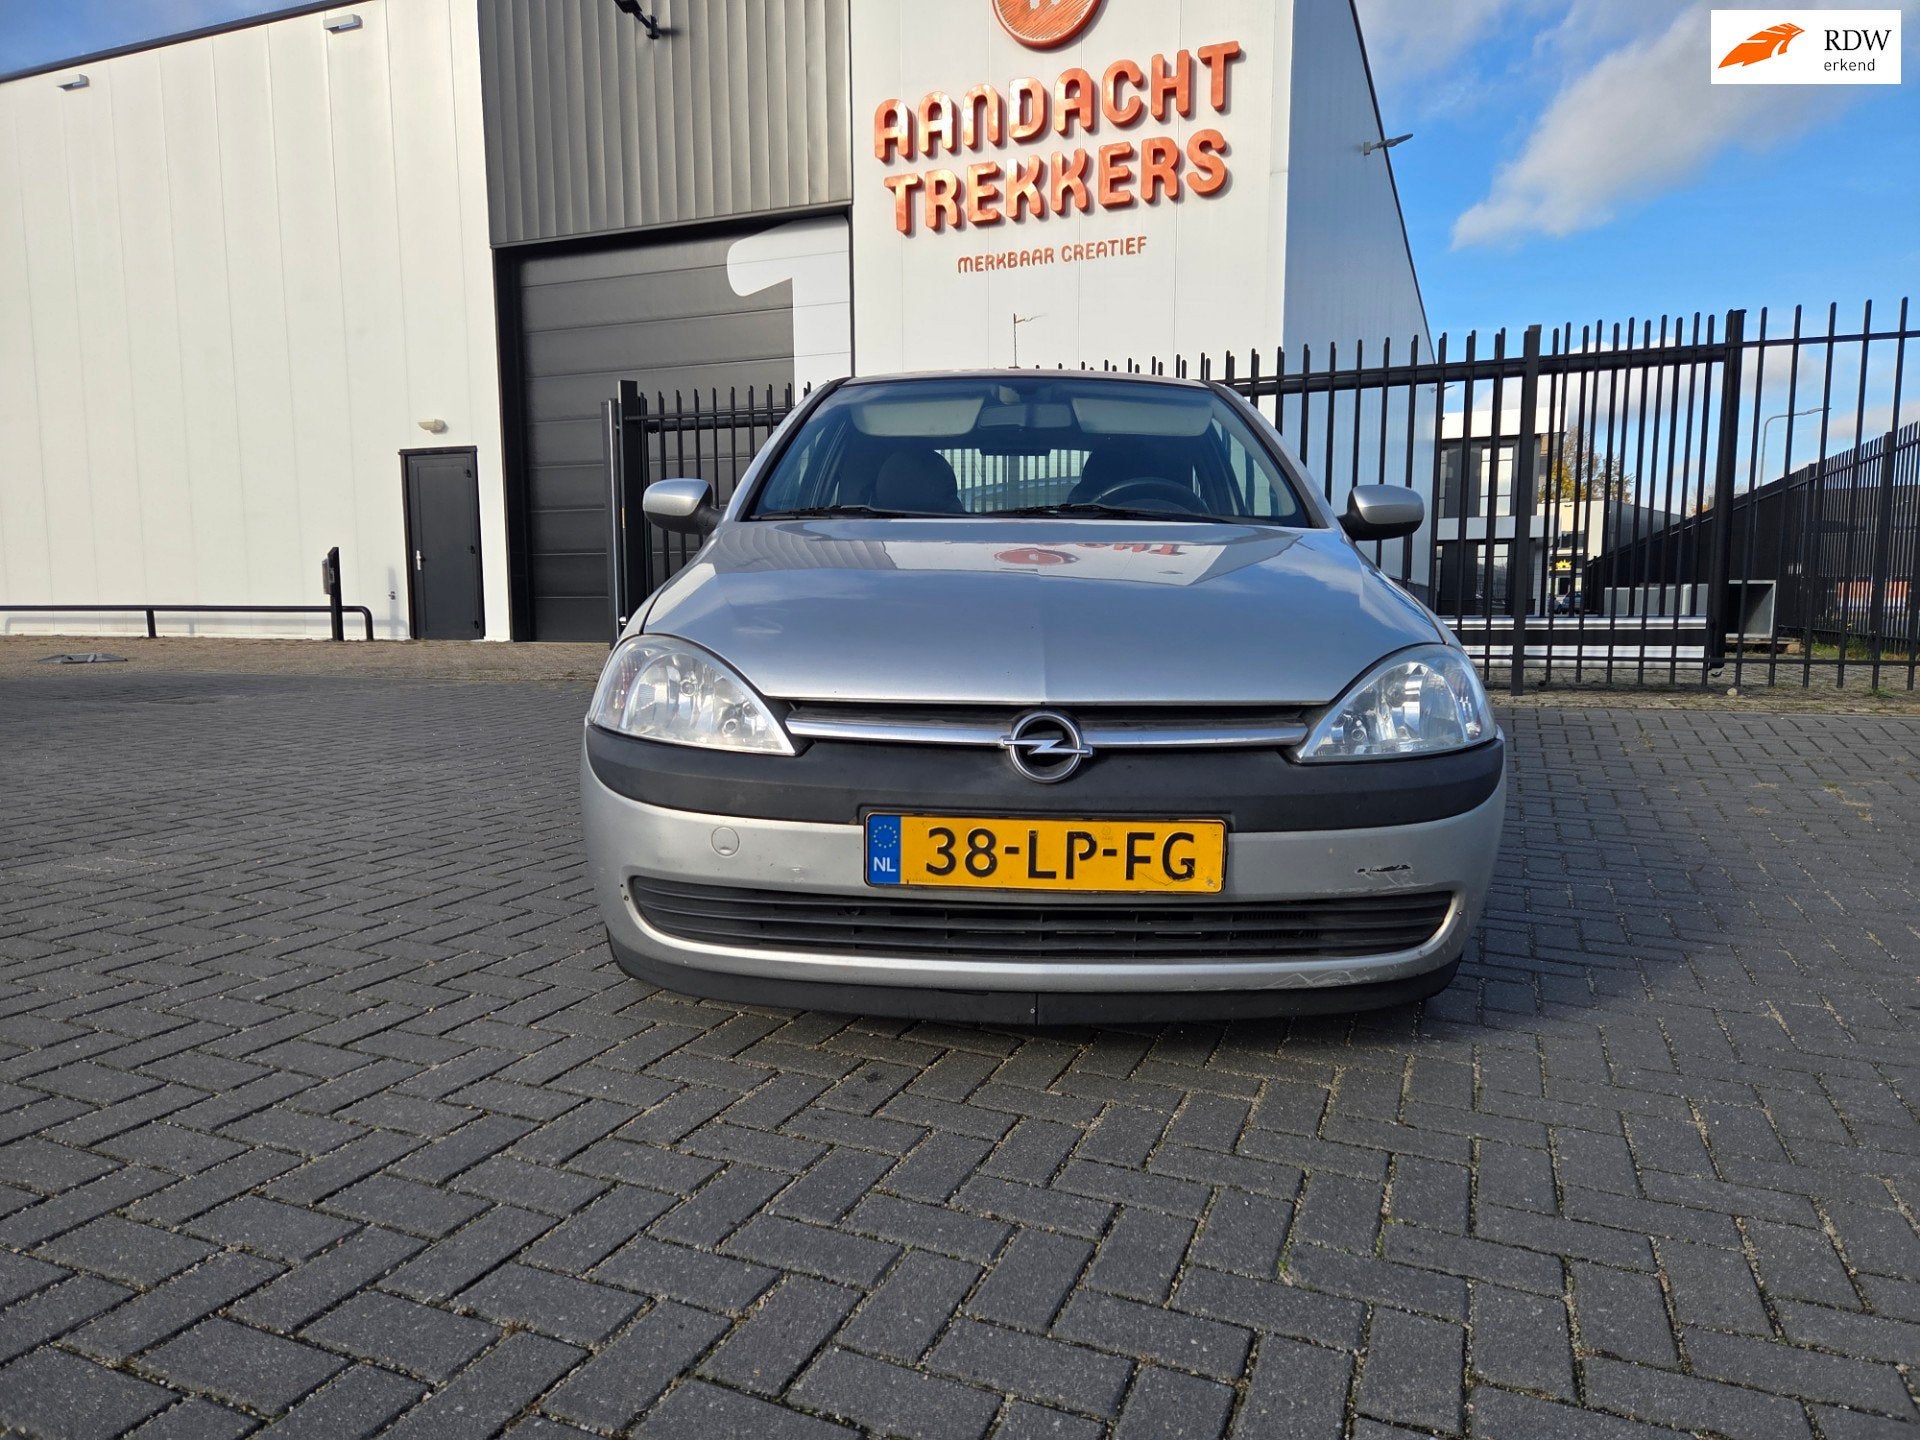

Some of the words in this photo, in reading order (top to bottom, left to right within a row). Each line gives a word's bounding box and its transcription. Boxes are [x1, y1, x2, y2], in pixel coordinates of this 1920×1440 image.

[874, 40, 1243, 162] AANDACHT
[884, 128, 1230, 235] TREKKERS
[957, 246, 1055, 275] MERKBAAR
[1061, 235, 1148, 263] CREATIEF
[873, 856, 897, 874] NL
[925, 826, 1196, 881] 38-LP-FG
